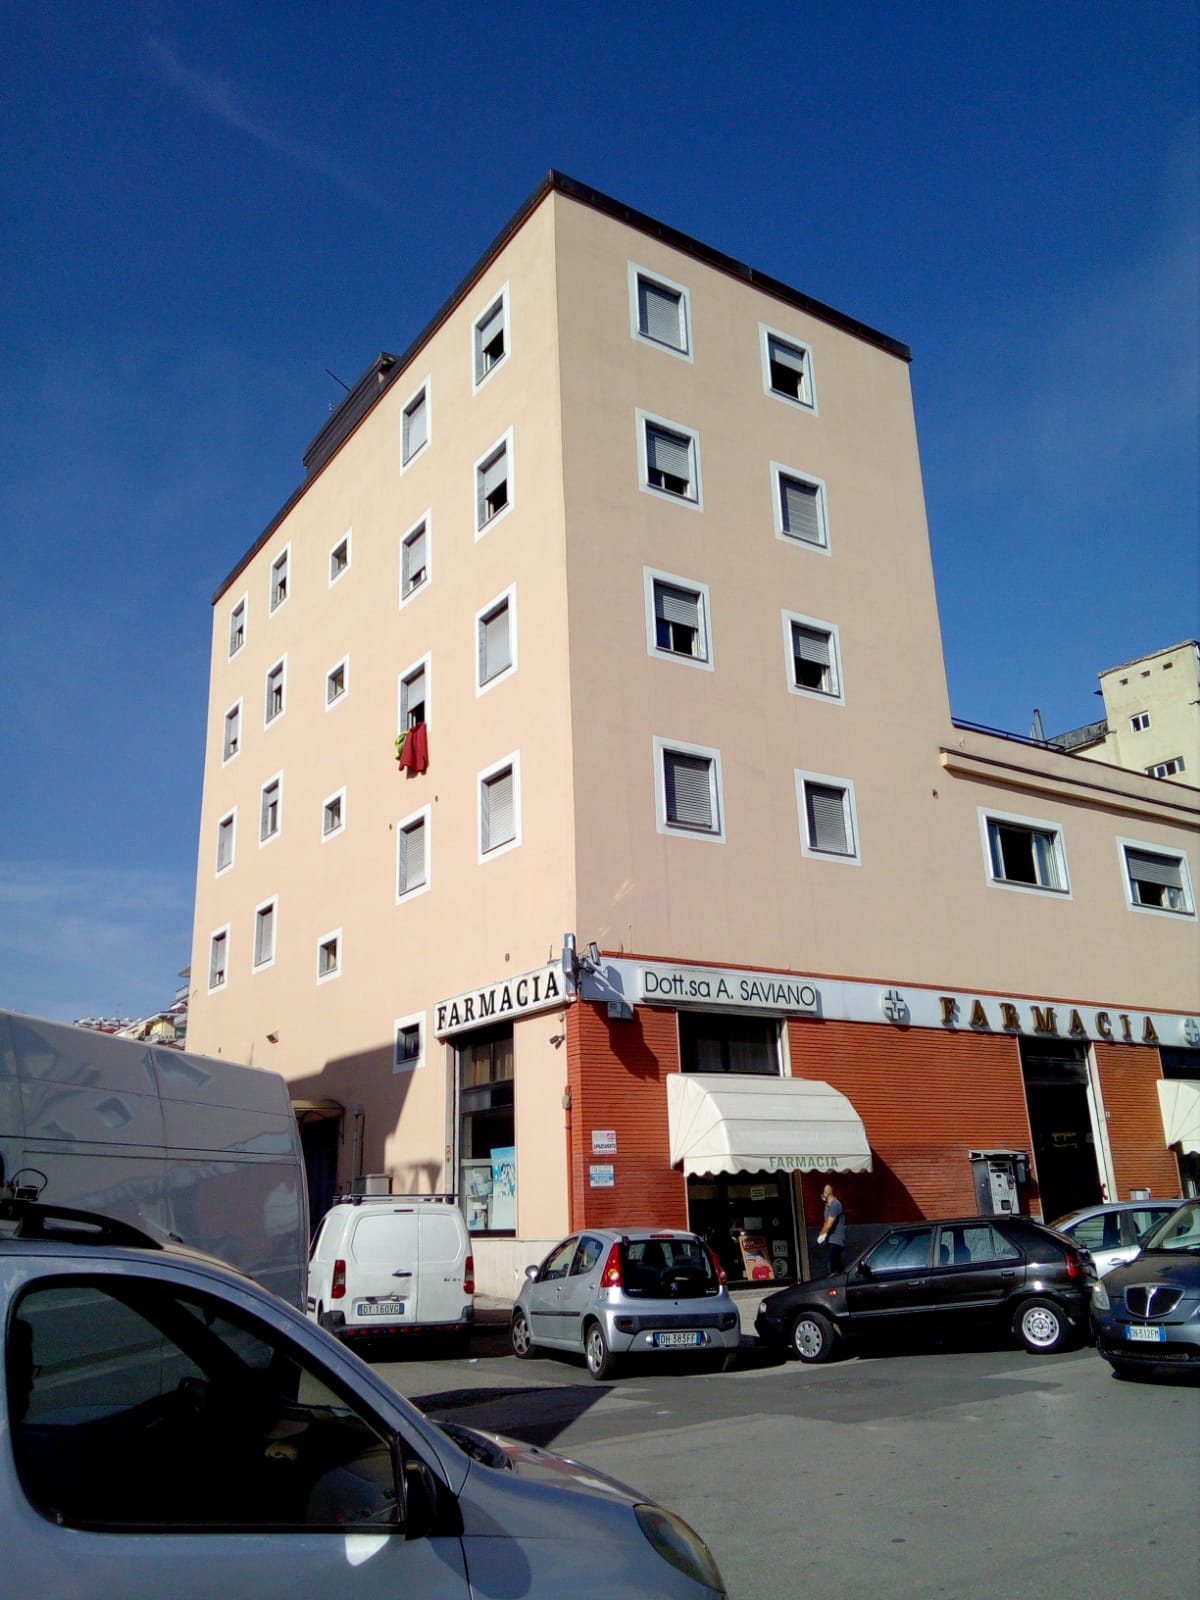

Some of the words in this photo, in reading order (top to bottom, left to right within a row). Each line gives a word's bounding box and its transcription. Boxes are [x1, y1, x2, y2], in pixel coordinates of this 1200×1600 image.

[437, 971, 559, 1030] FARMACIA
[645, 971, 711, 998] Dott.sa
[716, 979, 734, 999] A.
[740, 980, 816, 1007] SAVIANO
[938, 997, 1159, 1042] FARMACIA
[769, 1156, 839, 1168] FARMACIA
[660, 1334, 671, 1344] DH
